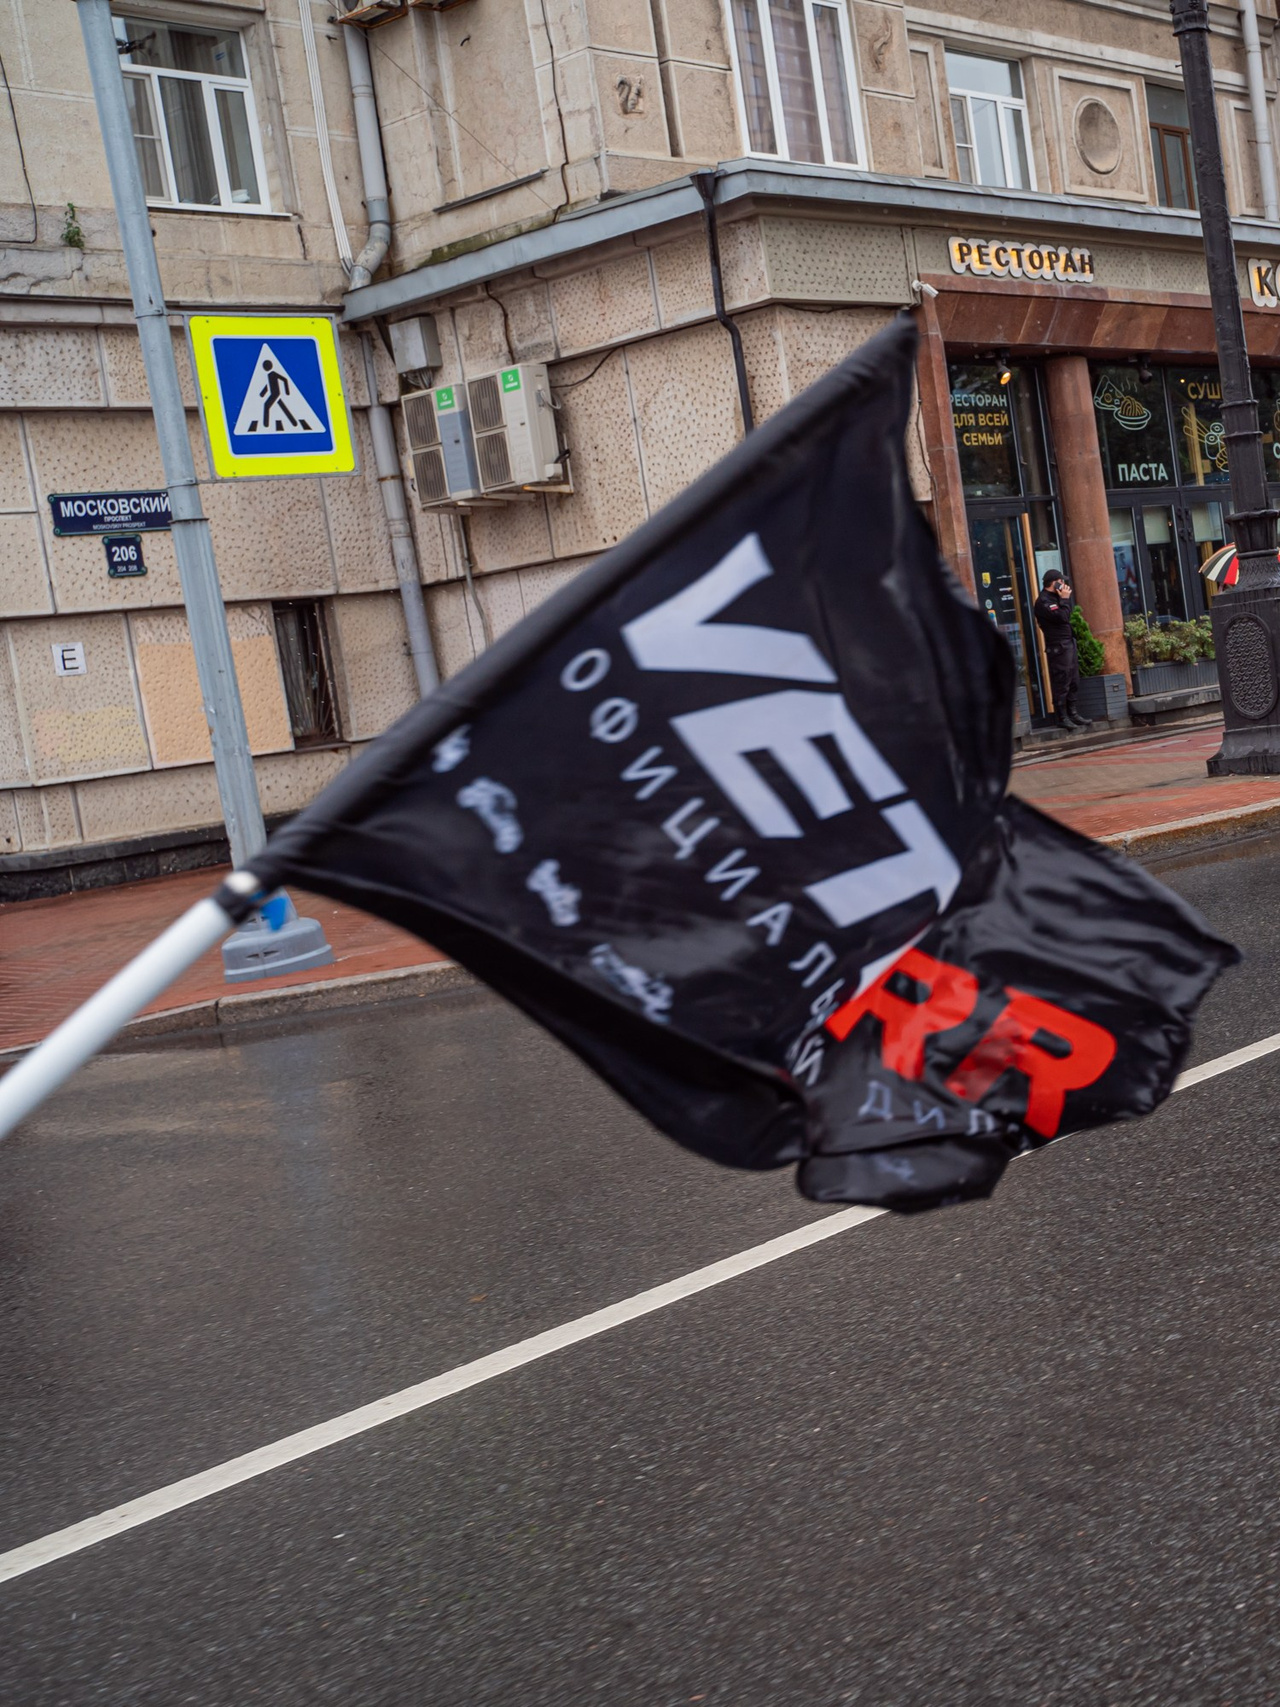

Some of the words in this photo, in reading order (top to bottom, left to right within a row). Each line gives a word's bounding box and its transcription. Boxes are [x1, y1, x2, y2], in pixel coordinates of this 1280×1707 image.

[956, 241, 1094, 275] РЕСТОРАН
[1187, 382, 1221, 399] СУШ
[950, 393, 1007, 407] РЕСТОРАН
[953, 413, 976, 428] ДЛЯ
[978, 411, 1009, 426] ВСЕЙ
[963, 432, 1003, 446] СЕМЬИ
[1118, 463, 1169, 482] ПАСТА
[60, 493, 171, 517] МОСКОВСКИЙ
[111, 545, 137, 562] 206
[621, 532, 1118, 1140] VETRR
